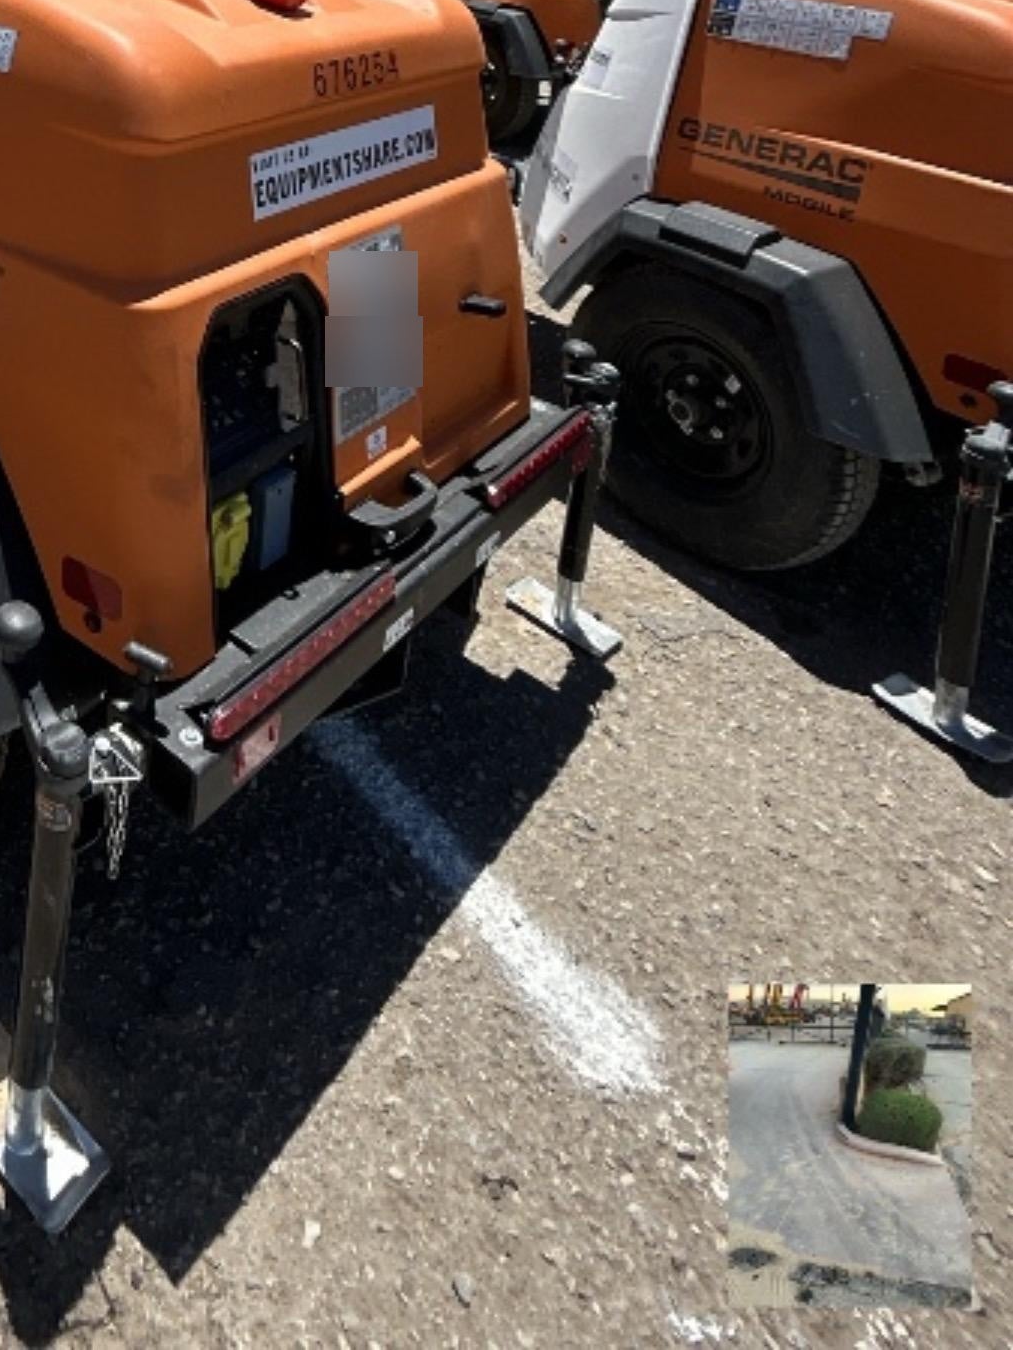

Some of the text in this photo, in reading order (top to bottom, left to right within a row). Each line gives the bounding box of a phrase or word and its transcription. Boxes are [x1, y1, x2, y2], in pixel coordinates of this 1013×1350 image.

[313, 52, 399, 97] 676254
[254, 129, 436, 208] EQUIPMENTSHARE.COM
[677, 116, 868, 184] GENERAC
[763, 185, 856, 221] MOBILE
